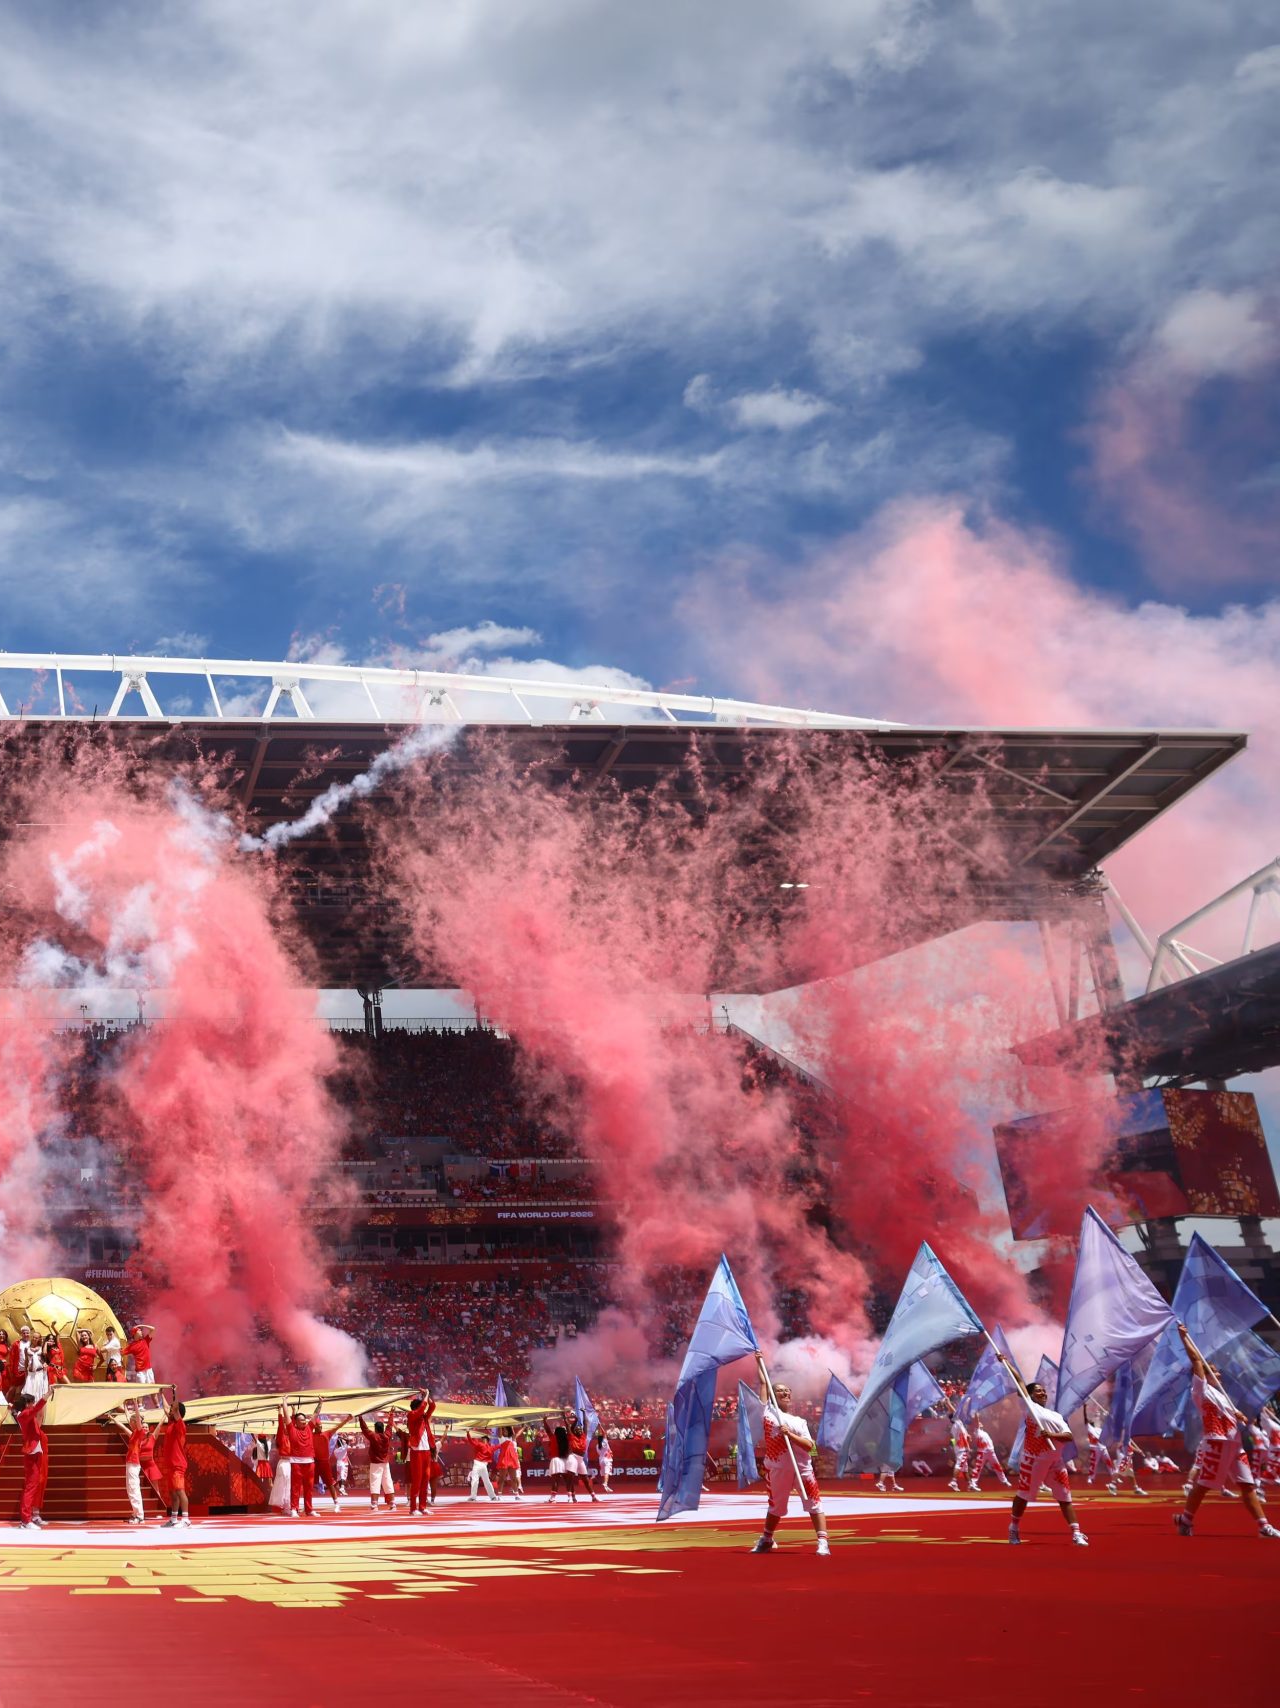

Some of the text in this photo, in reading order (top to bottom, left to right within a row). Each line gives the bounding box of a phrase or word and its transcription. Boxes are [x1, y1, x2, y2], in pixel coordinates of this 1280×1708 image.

[626, 1467, 658, 1476] 2026
[1019, 1455, 1035, 1491] FIFA
[1200, 1440, 1223, 1480] FIFA
